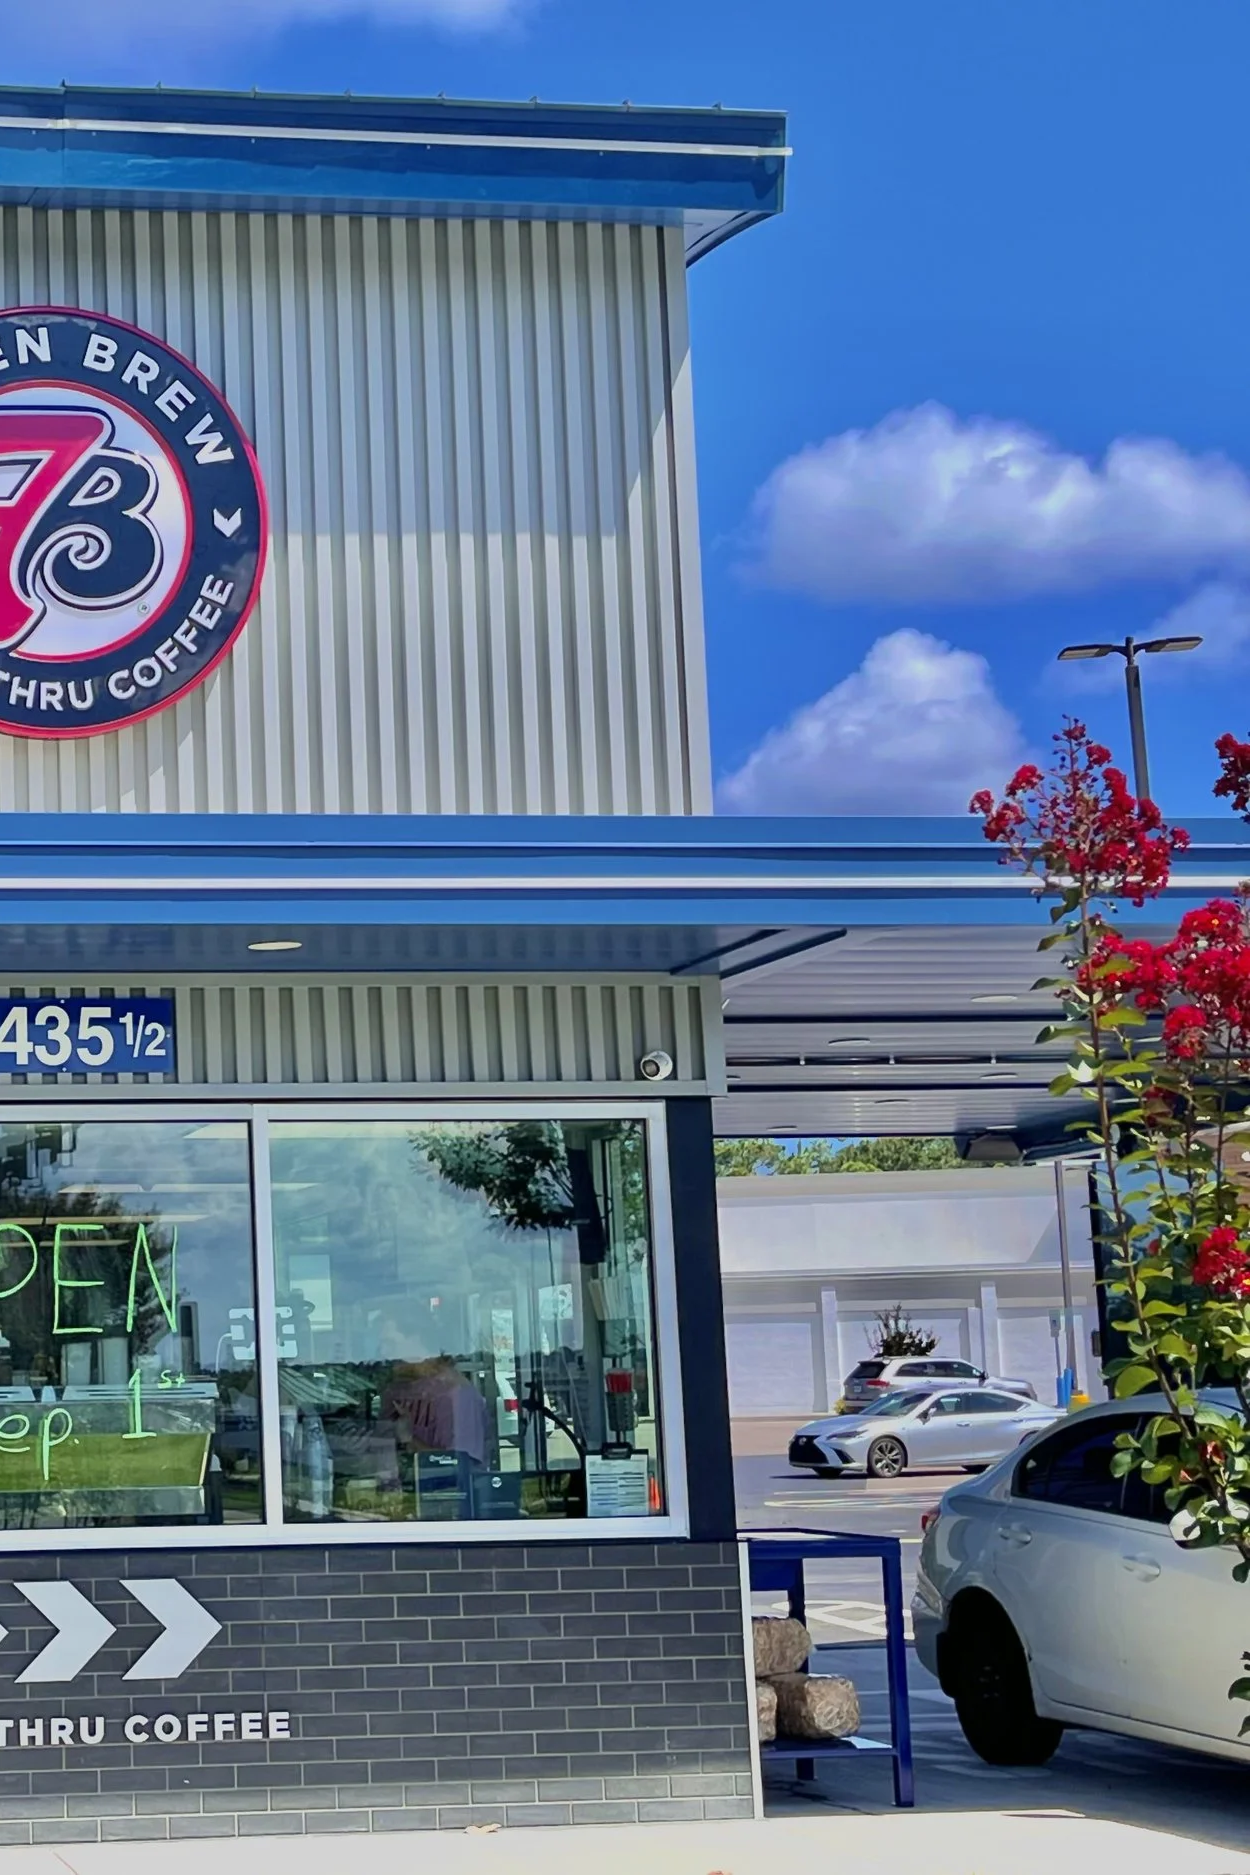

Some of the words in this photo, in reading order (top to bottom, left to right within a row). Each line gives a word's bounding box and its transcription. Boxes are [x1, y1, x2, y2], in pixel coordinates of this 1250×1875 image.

[82, 333, 234, 465] BREW
[108, 574, 234, 700] COFFEE
[119, 1012, 166, 1058] 1/2
[124, 1711, 291, 1743] COFFEE
